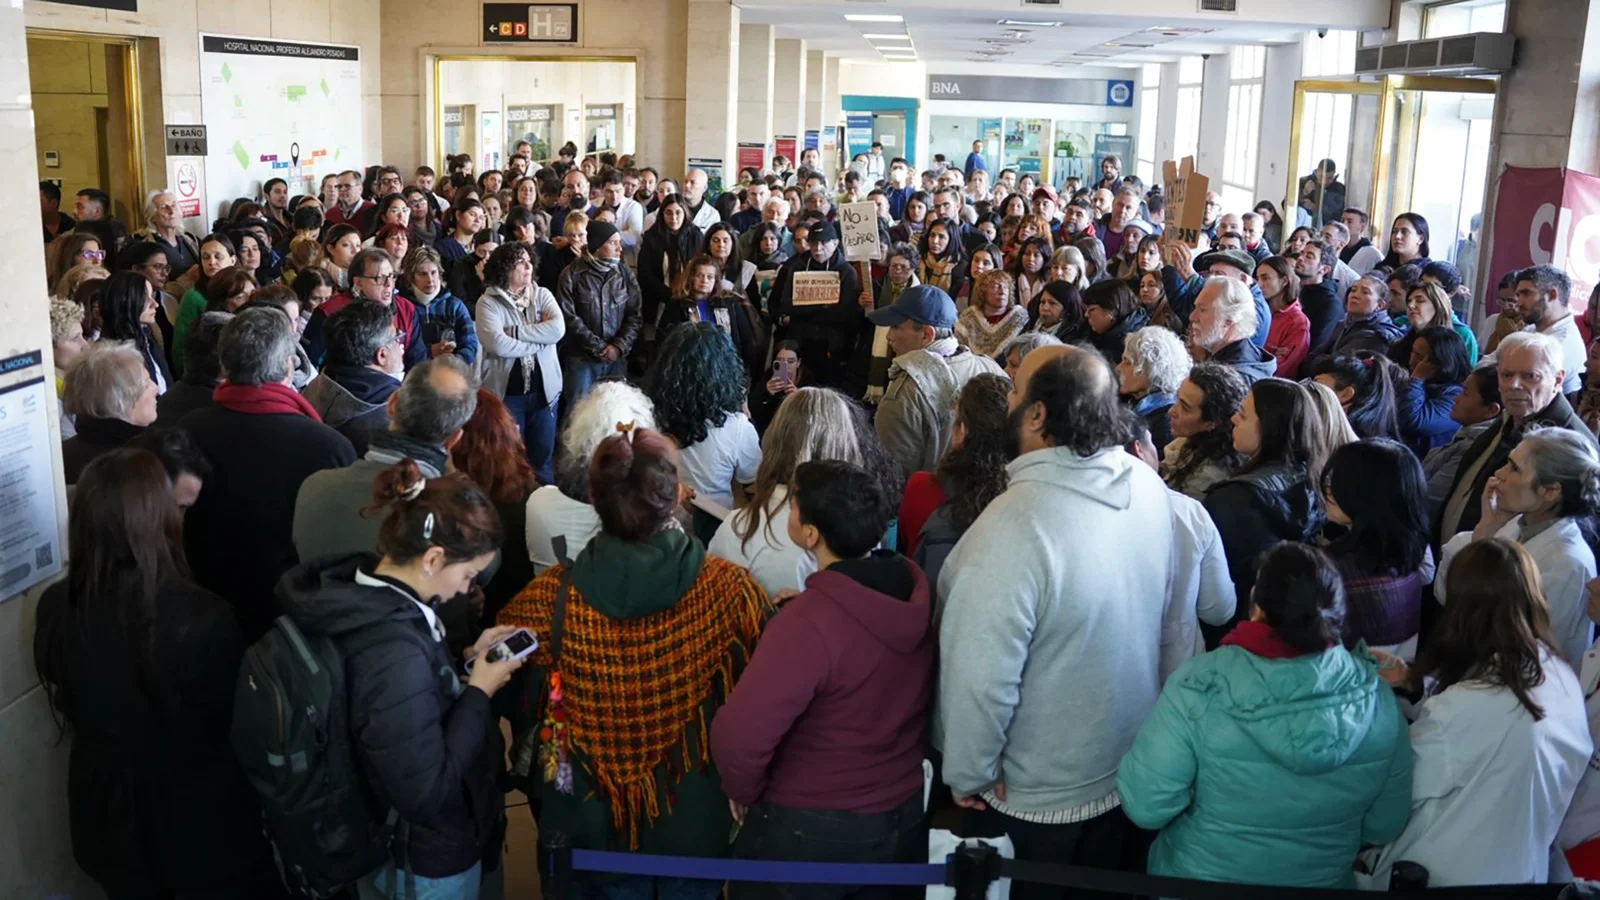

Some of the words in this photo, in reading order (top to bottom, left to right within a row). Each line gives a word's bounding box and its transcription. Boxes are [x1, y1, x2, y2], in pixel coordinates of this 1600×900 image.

[501, 23, 510, 35] C
[515, 23, 525, 35] D
[532, 13, 552, 36] H
[223, 41, 250, 52] HOSPITAL
[250, 43, 276, 53] NACIONAL
[276, 45, 301, 55] PROFESOR
[301, 47, 326, 56] ALEJANDRO
[326, 49, 346, 58] POSADAS
[931, 82, 961, 94] BNA
[180, 128, 203, 137] BAÑO
[843, 208, 861, 224] NO
